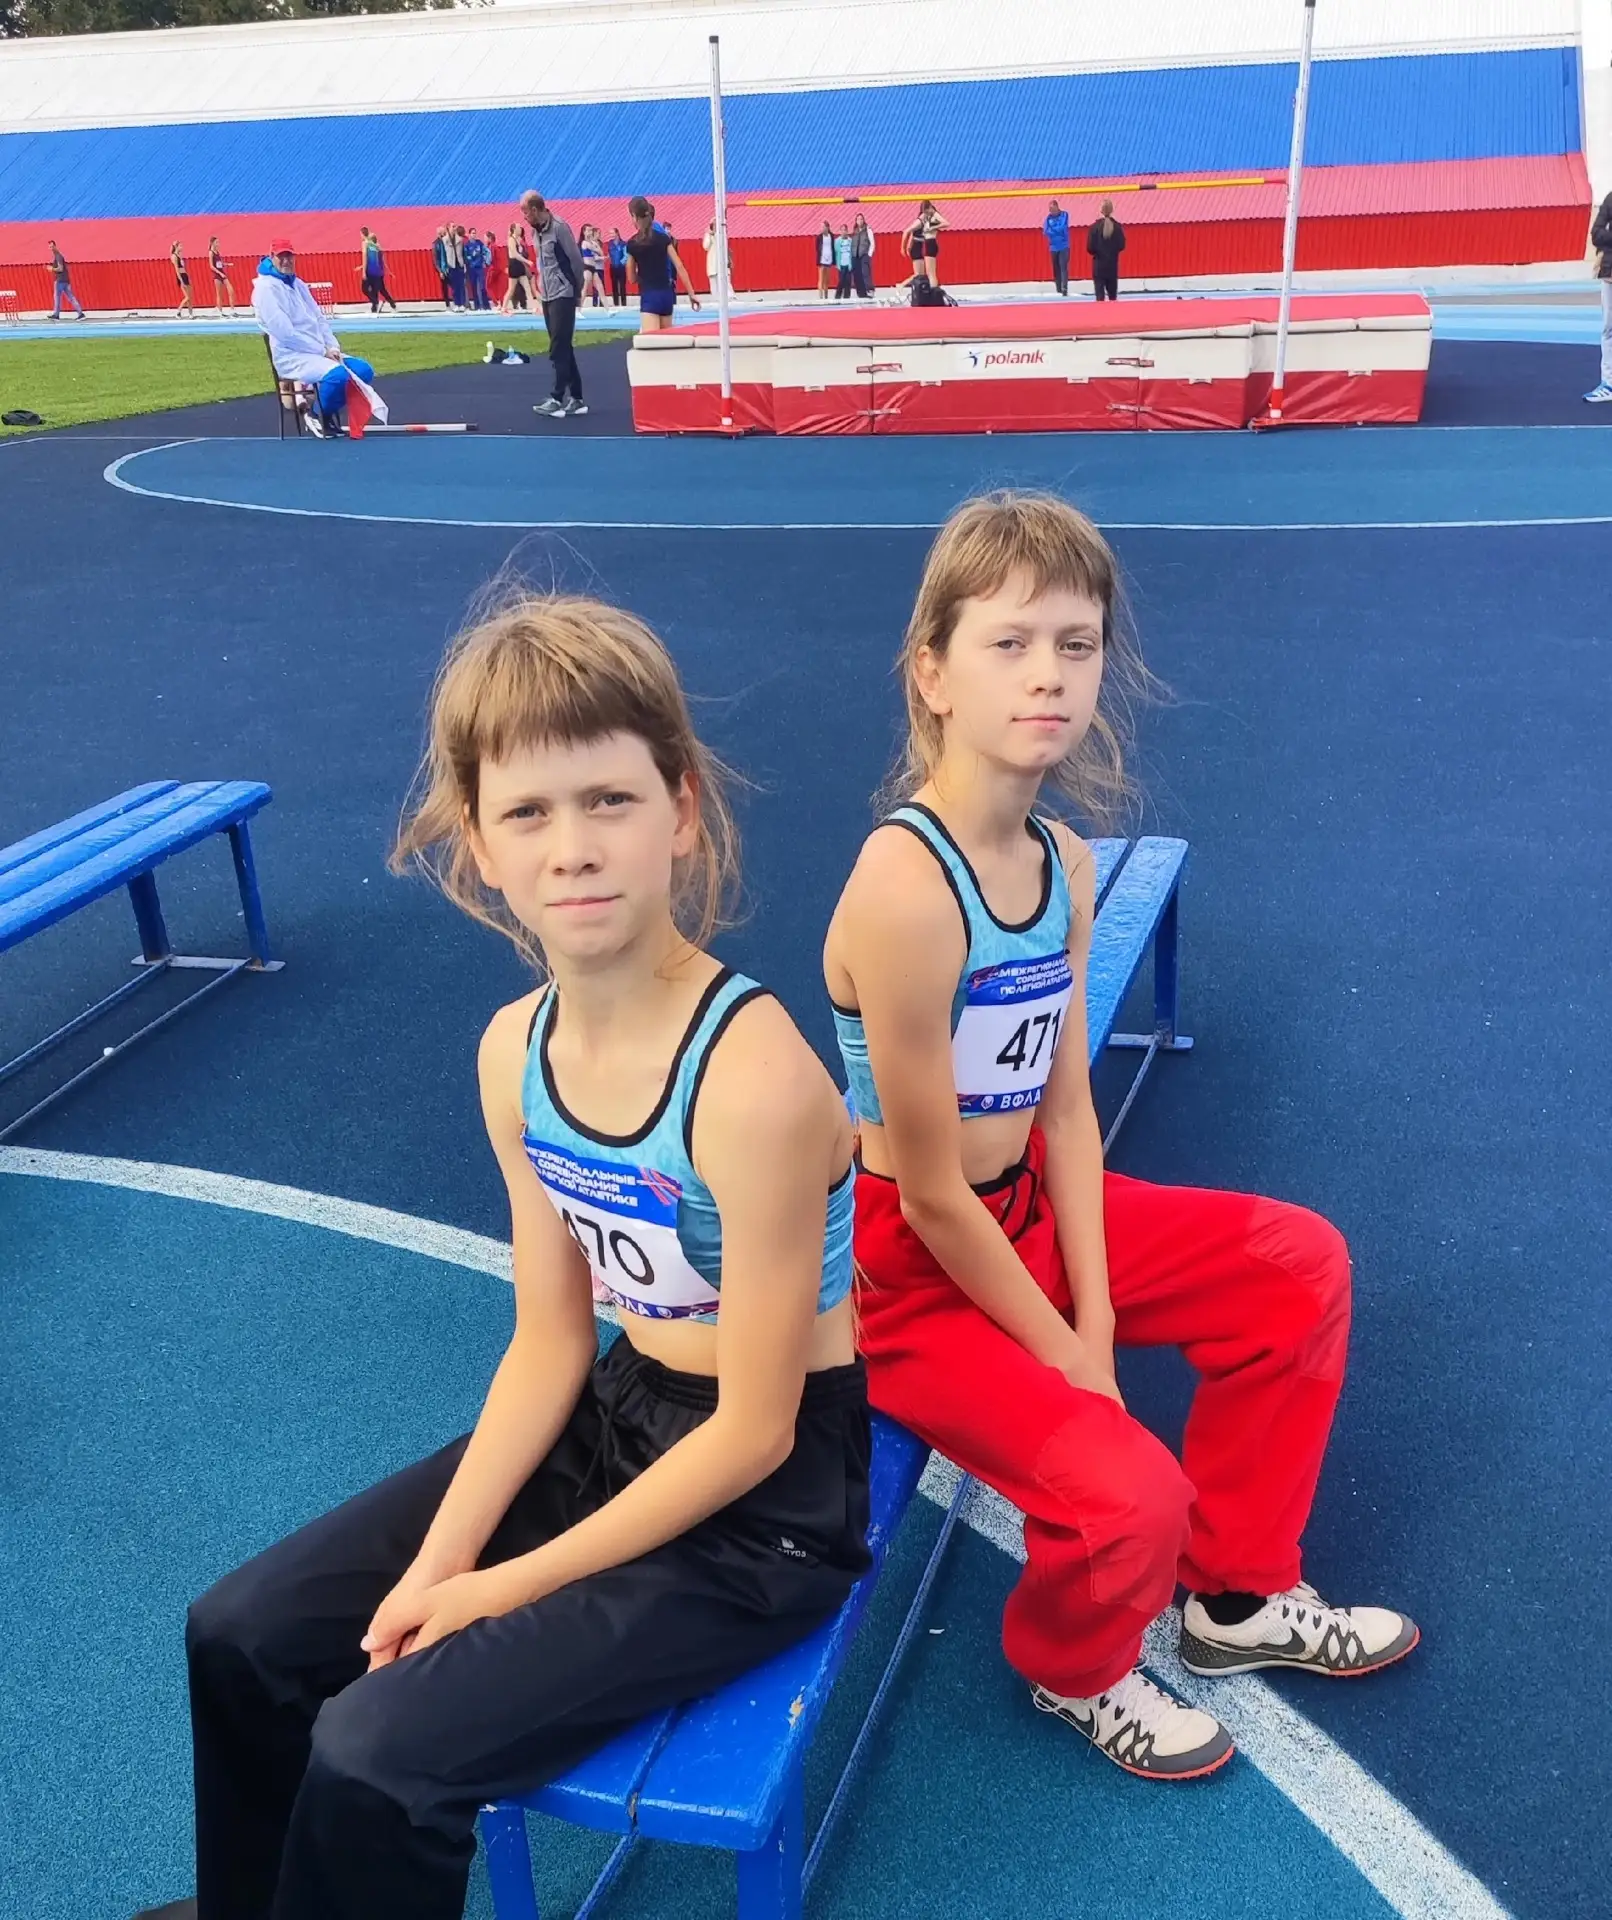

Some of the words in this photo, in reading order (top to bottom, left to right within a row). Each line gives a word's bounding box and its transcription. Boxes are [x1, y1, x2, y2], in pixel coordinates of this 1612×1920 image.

[984, 349, 1046, 369] polanik
[1000, 985, 1016, 995] ПО
[996, 1008, 1061, 1071] 471
[1000, 1088, 1041, 1109] ВФЛА
